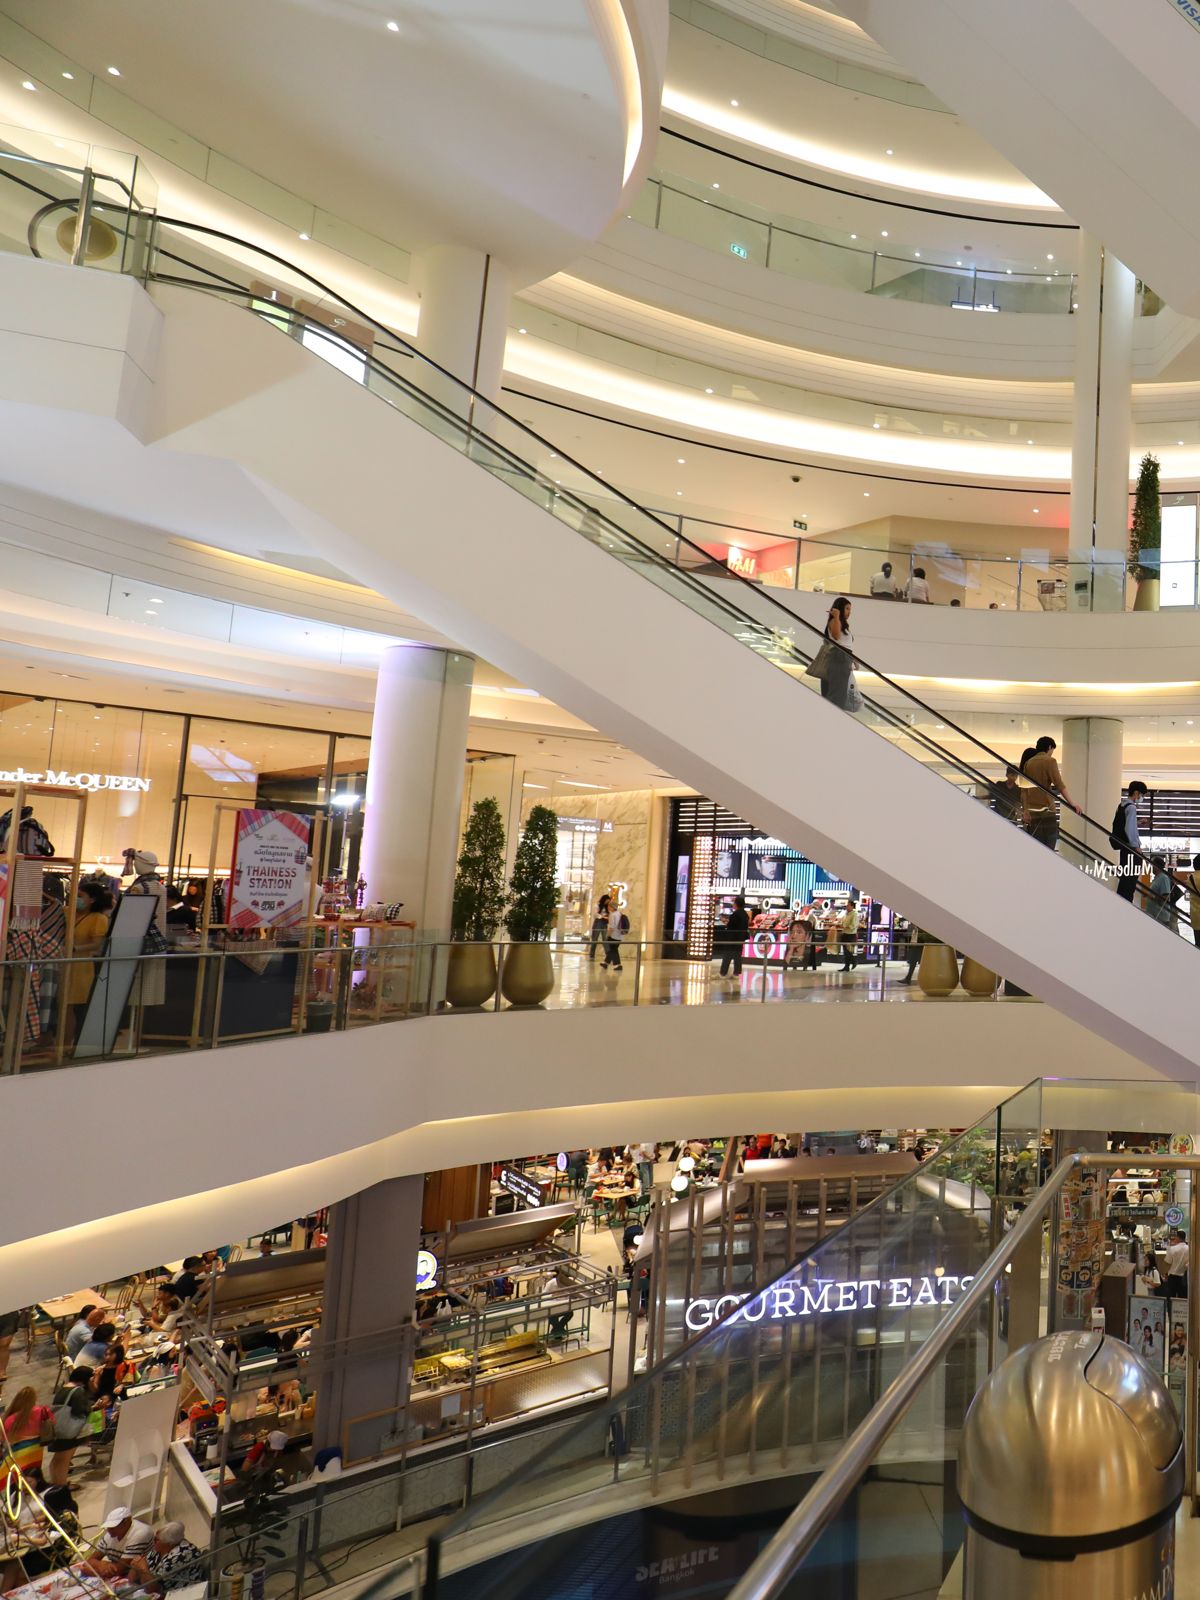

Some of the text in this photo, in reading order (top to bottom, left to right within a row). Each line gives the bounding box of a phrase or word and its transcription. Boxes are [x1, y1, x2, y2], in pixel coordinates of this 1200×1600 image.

[45, 770, 152, 792] McQUEEN
[246, 865, 297, 878] THAINESS
[249, 879, 292, 890] STATION
[685, 1279, 881, 1331] GOURMET
